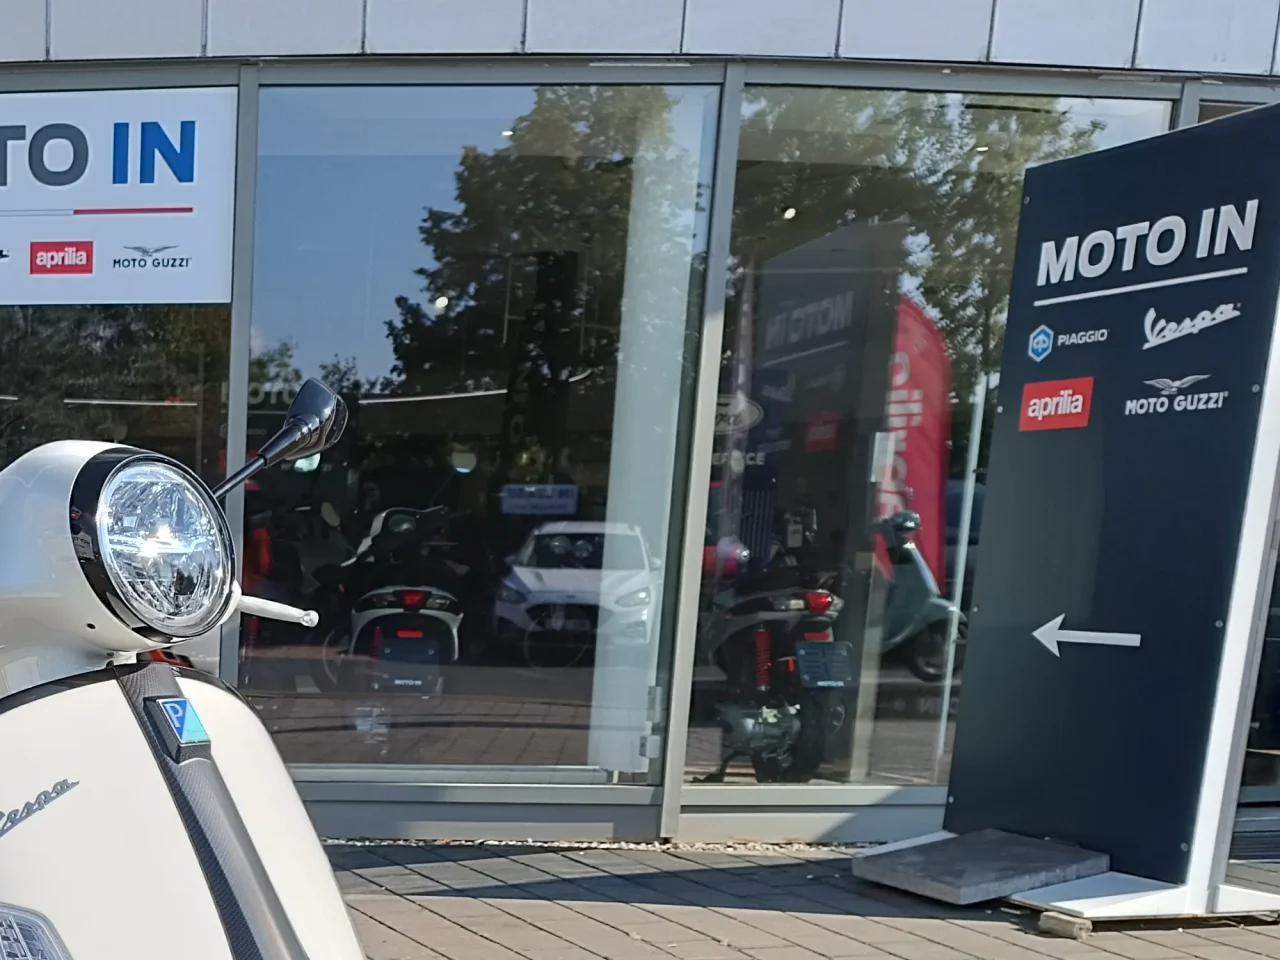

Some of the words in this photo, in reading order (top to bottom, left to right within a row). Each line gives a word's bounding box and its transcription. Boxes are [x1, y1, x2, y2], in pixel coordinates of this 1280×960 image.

[112, 120, 196, 184] IN
[1036, 215, 1187, 287] MOTO
[1196, 198, 1259, 259] IN
[35, 248, 87, 269] aprilia
[112, 258, 148, 269] MOTO
[152, 257, 190, 269] GUZZI
[1056, 328, 1110, 347] PIAGGIO
[1142, 302, 1241, 350] Vespa
[1026, 389, 1085, 421] aprilia
[1124, 396, 1169, 416] MOTO
[1173, 392, 1225, 412] GUZZI
